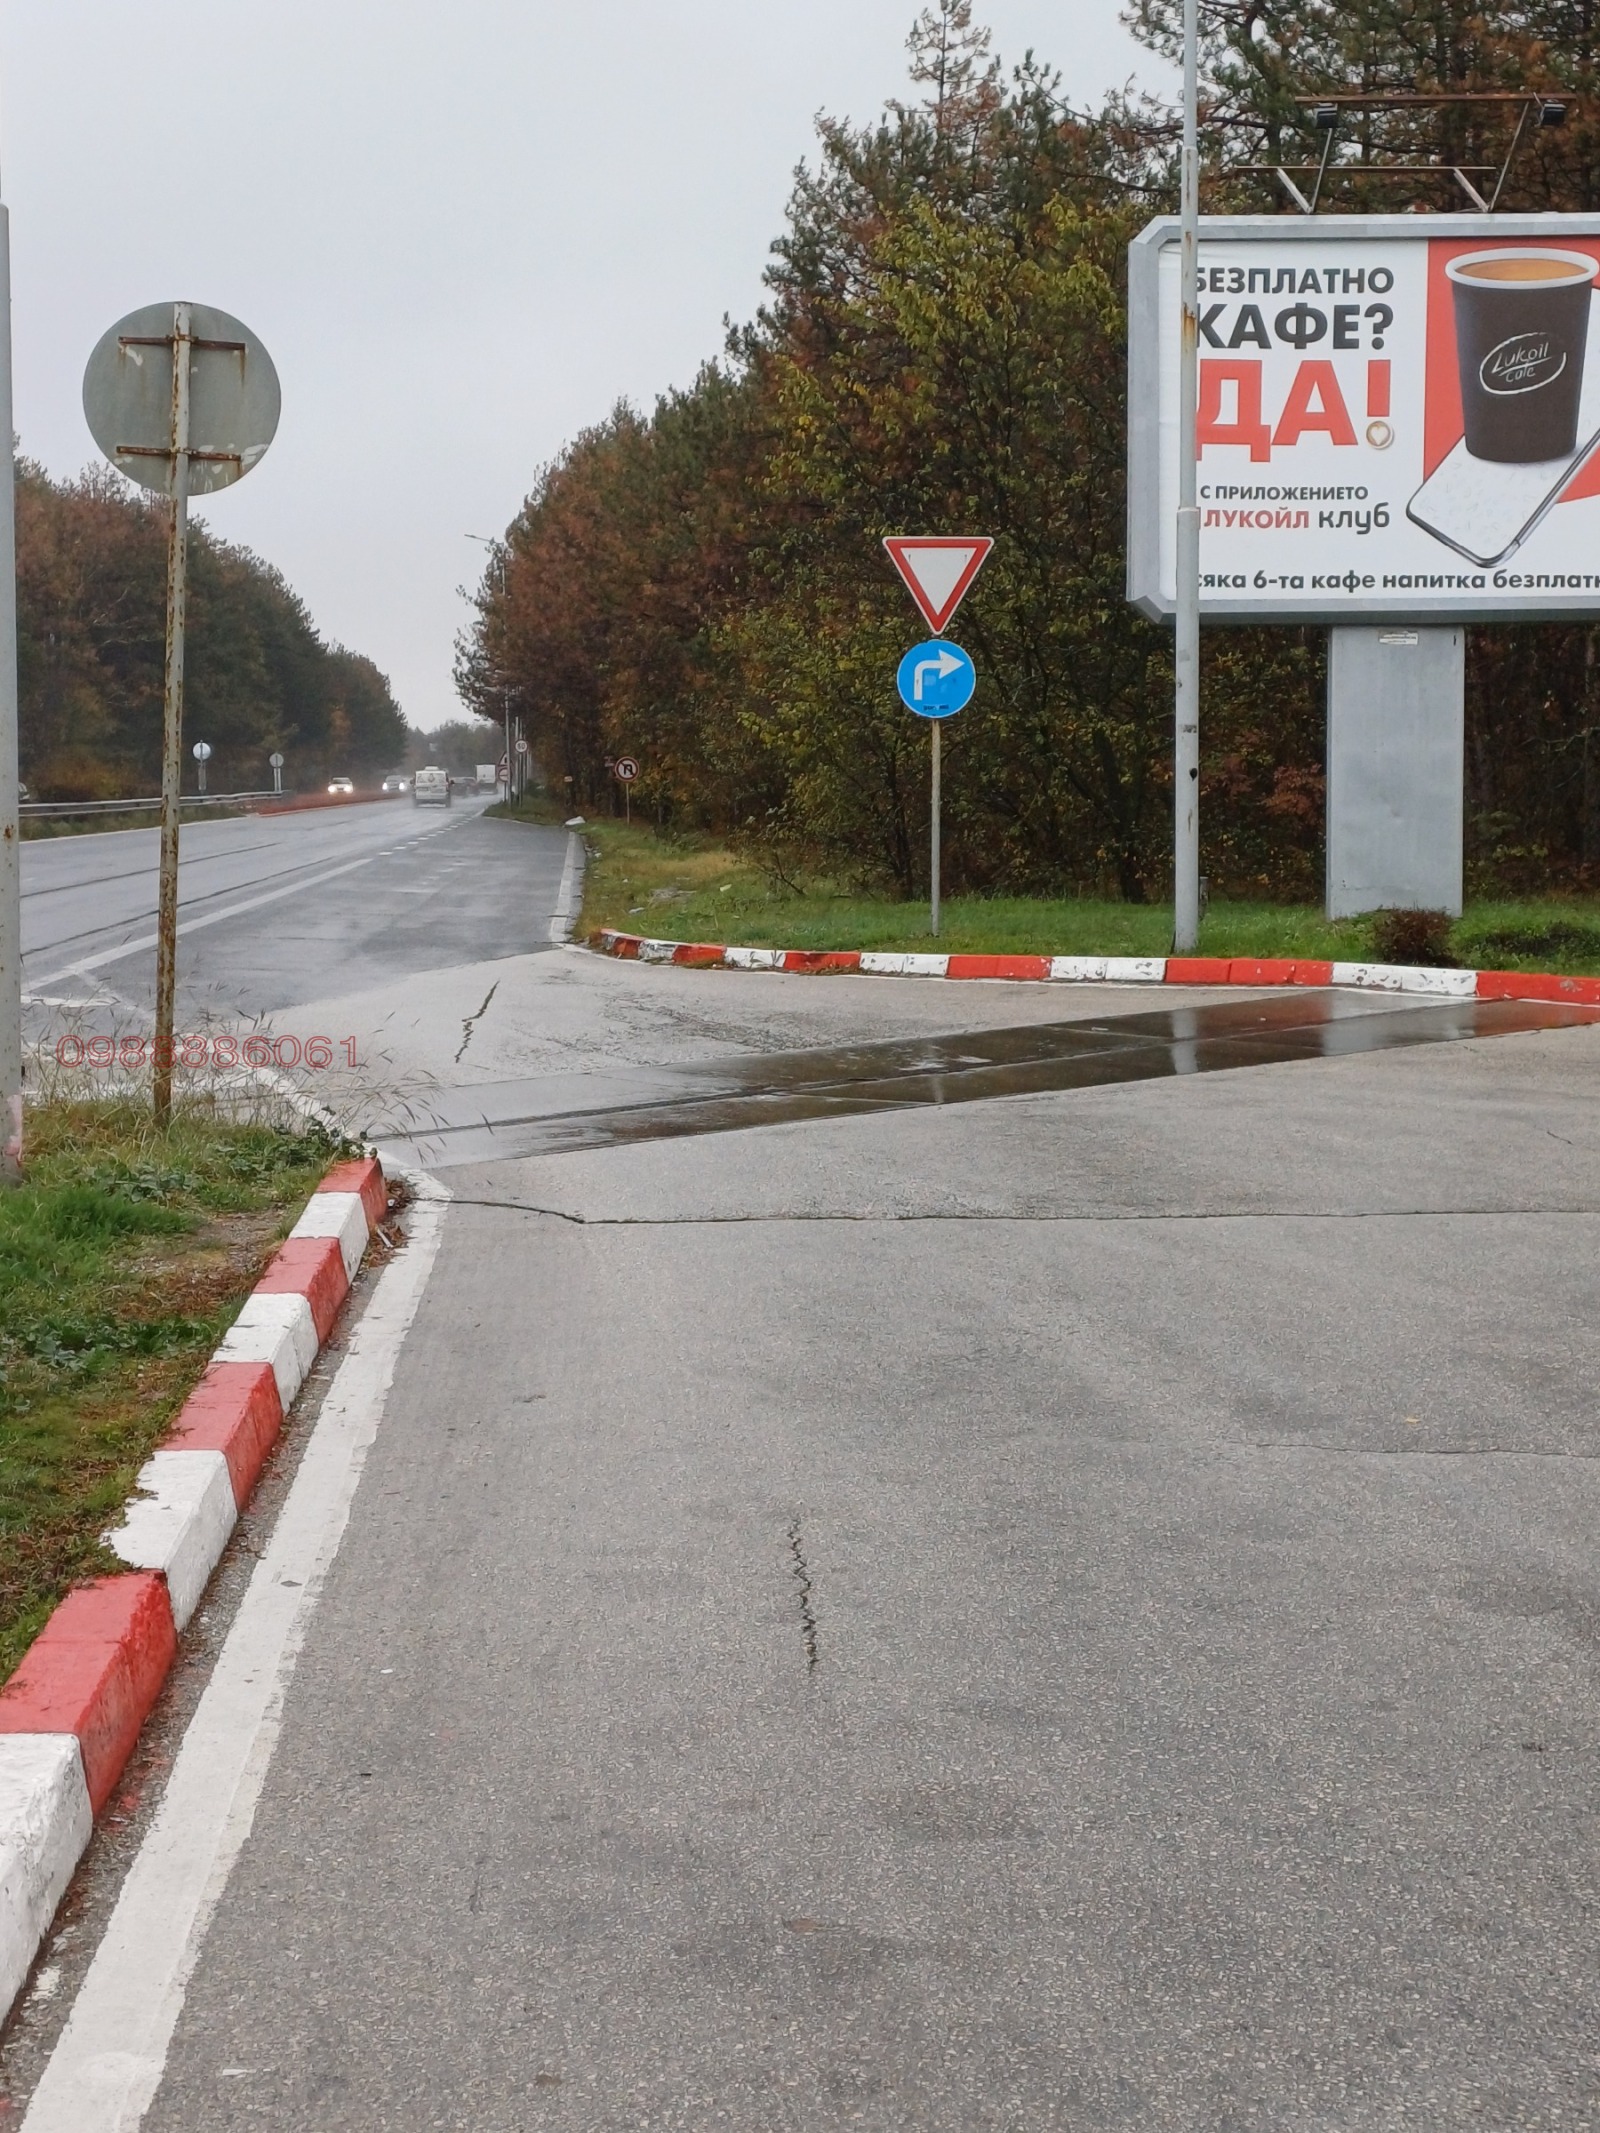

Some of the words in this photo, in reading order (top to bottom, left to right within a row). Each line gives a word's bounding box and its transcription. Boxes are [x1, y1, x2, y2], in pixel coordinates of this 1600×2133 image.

[1197, 302, 1394, 350] КАФЕ?
[1491, 342, 1549, 374] Lukoil
[1196, 358, 1394, 462] ДА!
[1200, 485, 1211, 499] С
[1215, 486, 1369, 500] ПРИЛОЖЕНИЕТО
[1203, 506, 1310, 529] ЛУКОЙЛ
[1318, 502, 1390, 535] клуб
[1253, 570, 1304, 589] 6-та
[1311, 570, 1376, 593] кафе
[1382, 573, 1486, 589] напитка
